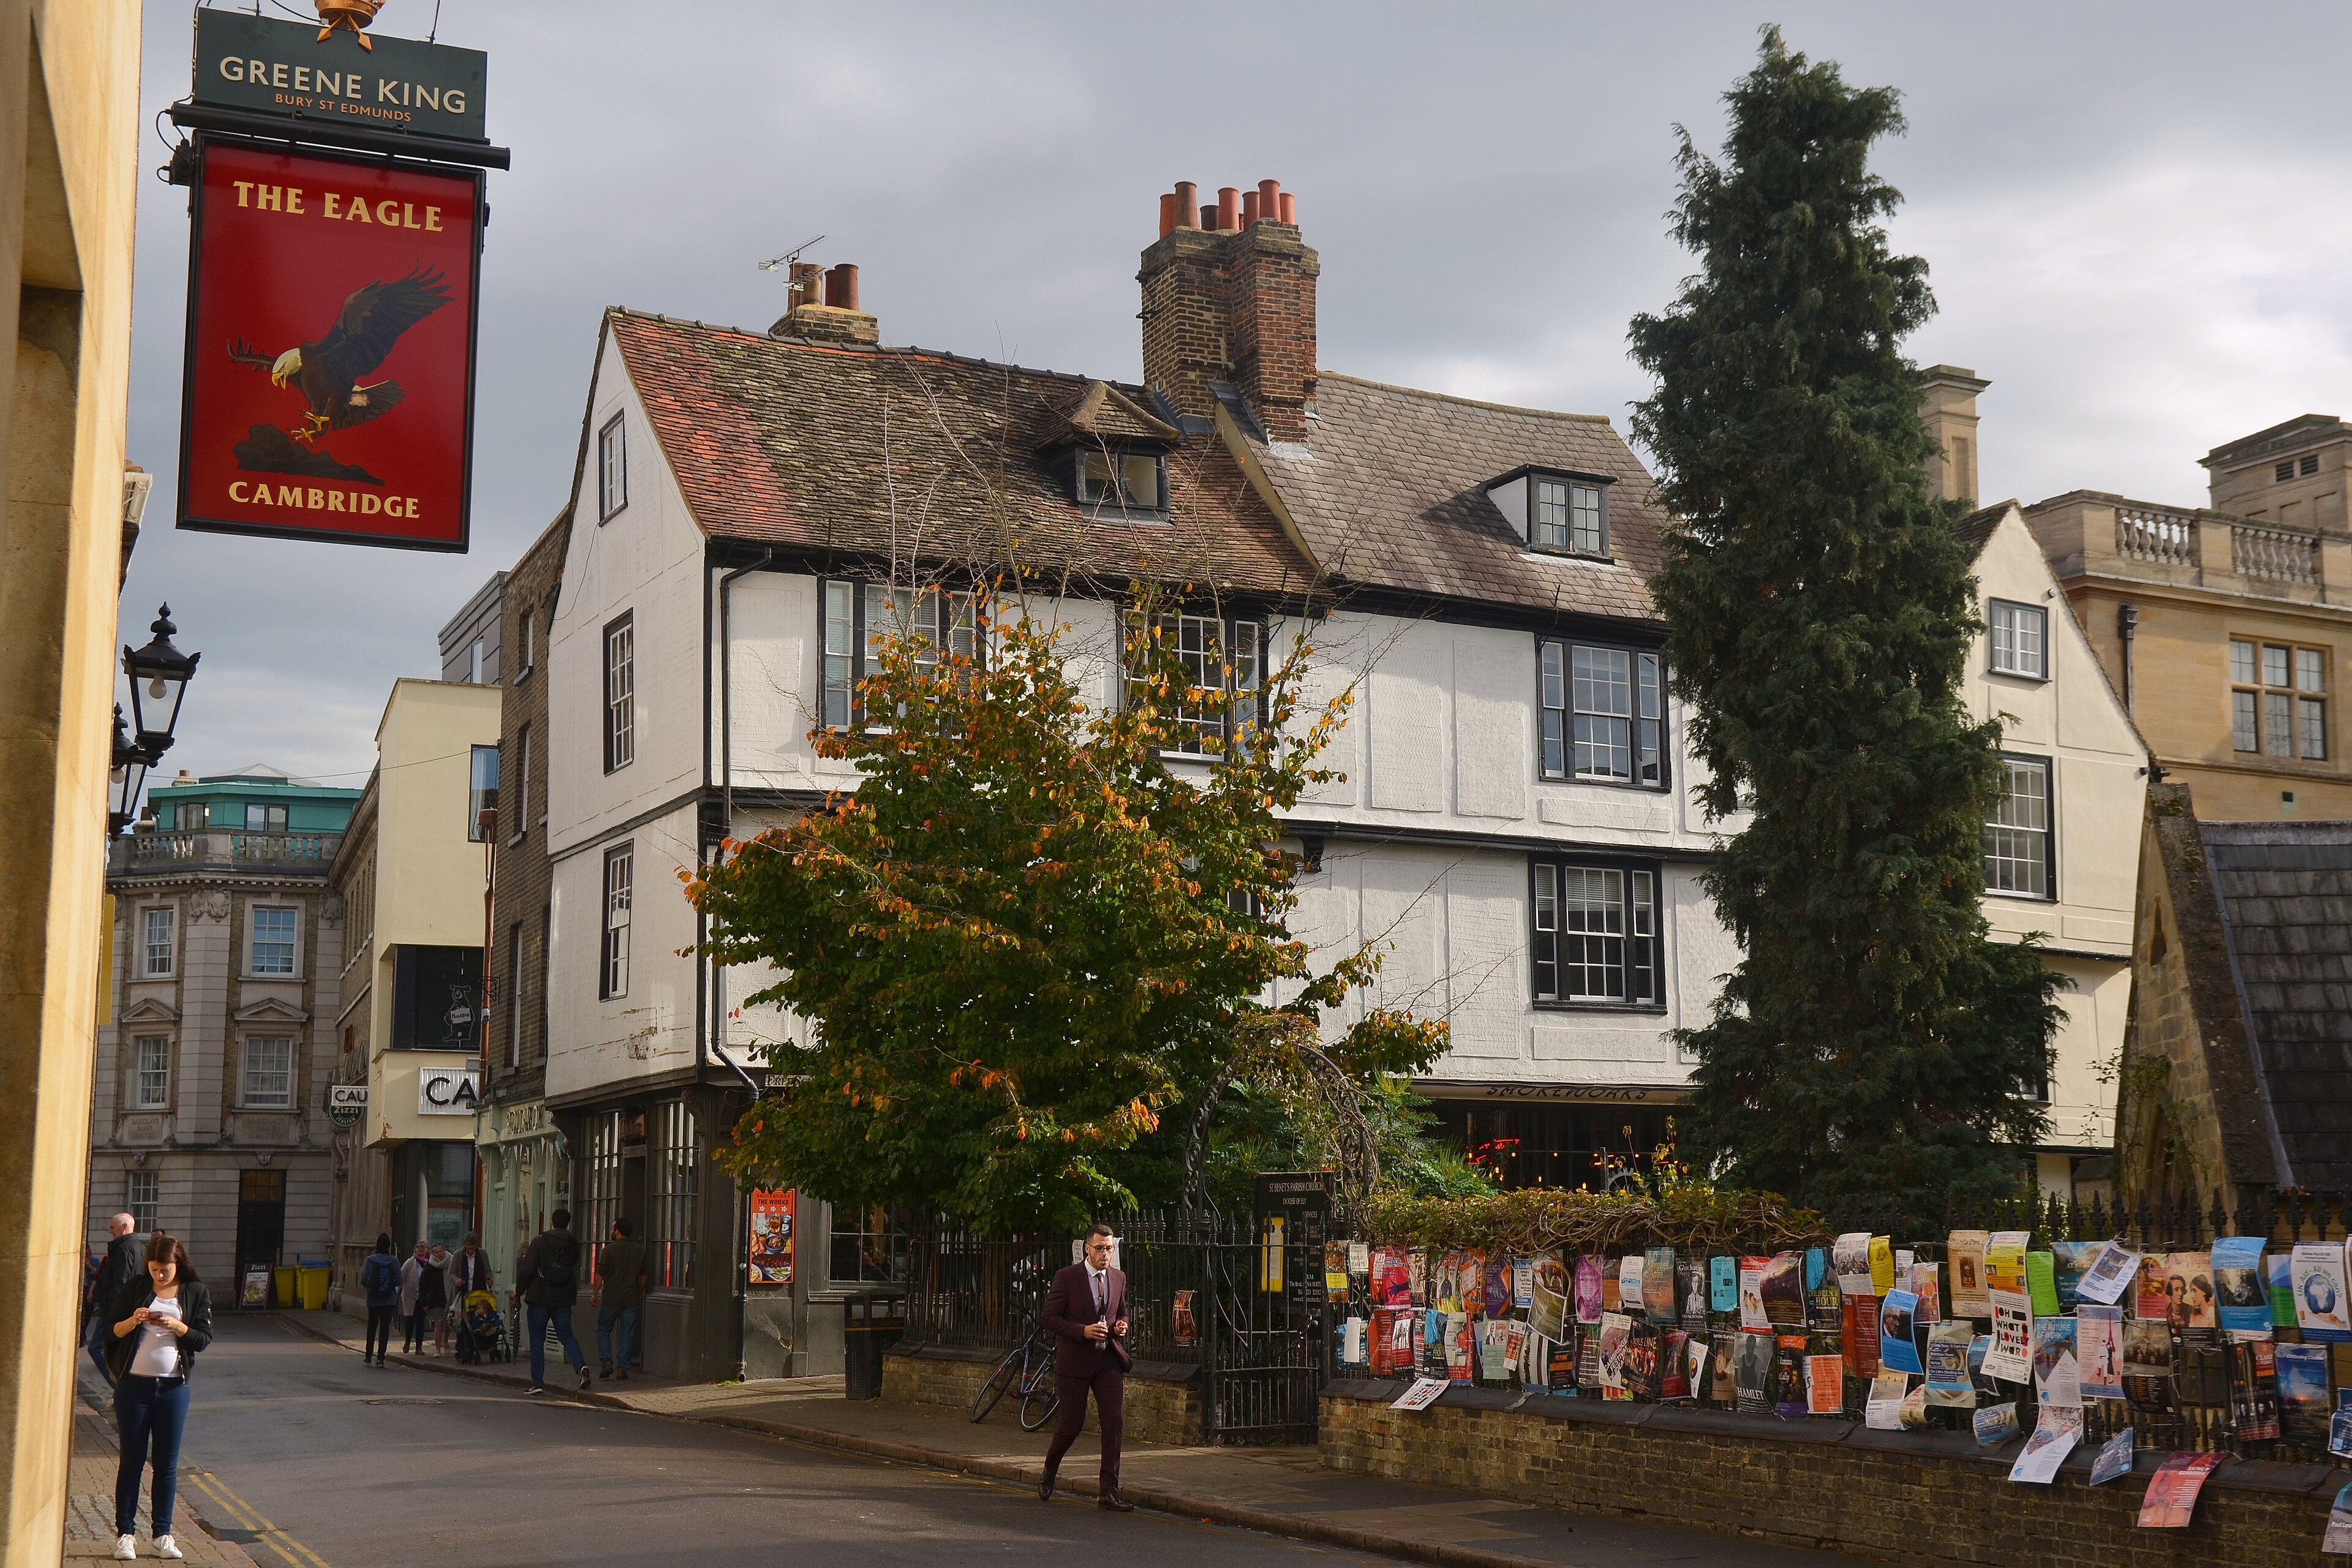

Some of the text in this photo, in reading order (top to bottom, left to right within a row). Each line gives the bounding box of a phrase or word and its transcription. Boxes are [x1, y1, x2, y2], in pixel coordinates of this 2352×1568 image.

[220, 56, 466, 114] GREENE KING
[275, 94, 411, 122] BURY ST EDMUNDS
[233, 181, 443, 232] THE EAGLE
[228, 481, 420, 519] CAMBRIDGE
[335, 1090, 368, 1102] CAU
[1486, 1086, 1648, 1100] SMOKEWORKS
[1290, 1182, 1305, 1192] PARISH
[1305, 1182, 1323, 1191] CHURCH
[1373, 1262, 1384, 1271] SIDE
[1651, 1260, 1670, 1269] Farewell
[2300, 1269, 2310, 1281] Aid
[2322, 1268, 2332, 1278] we
[2297, 1284, 2304, 1296] UK
[2331, 1278, 2342, 1298] can?
[1815, 1297, 1839, 1306] HOUR
[1999, 1307, 2010, 1317] OH
[1644, 1336, 1657, 1349] LINE
[2000, 1332, 2029, 1346] LOVELY
[1604, 1336, 1628, 1371] CAMBRIDGE
[1736, 1387, 1764, 1400] HAMLET
